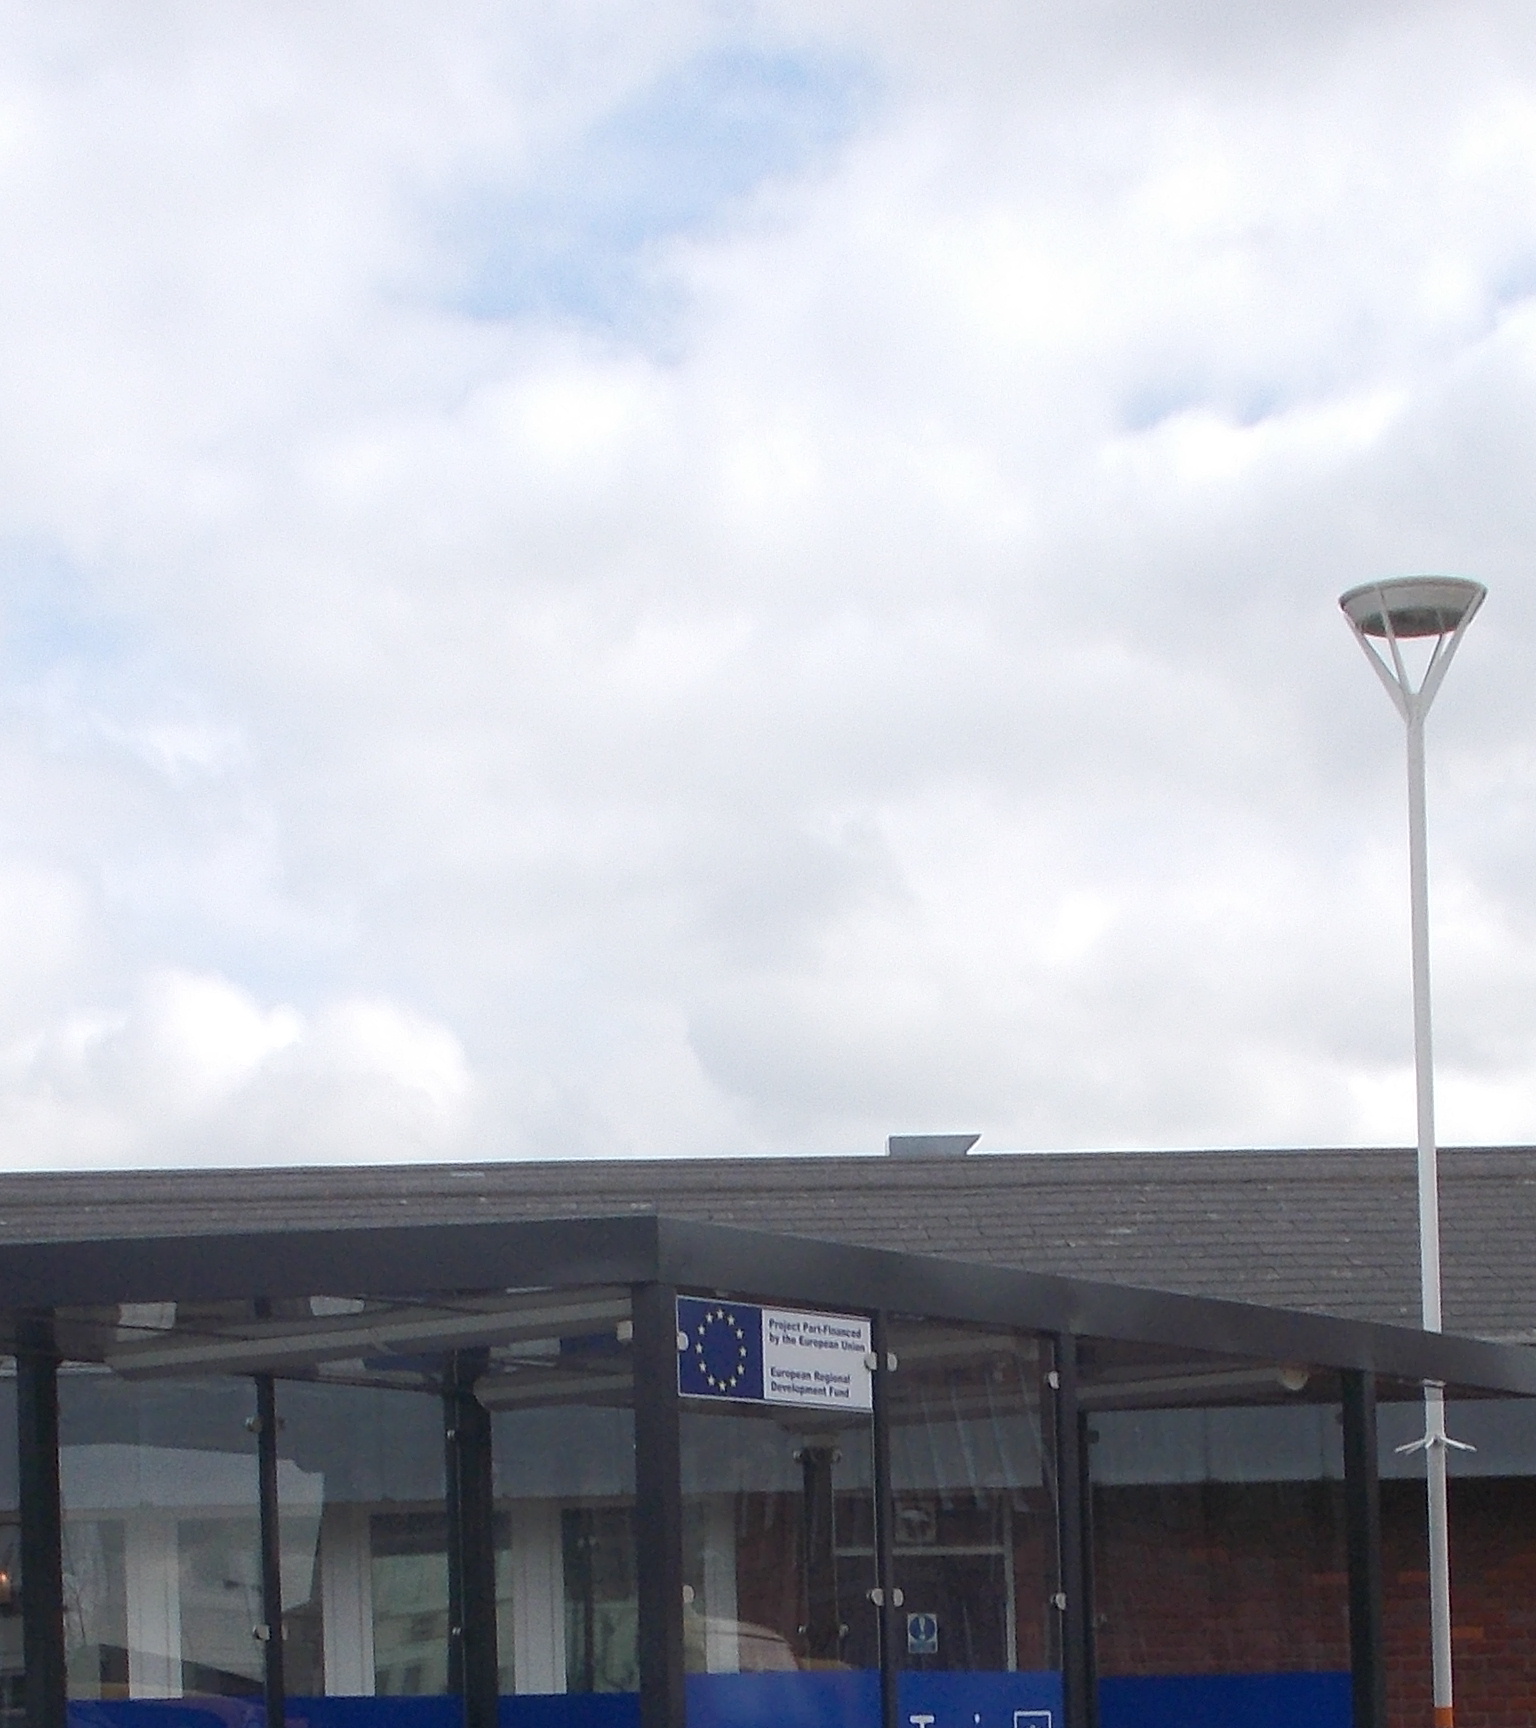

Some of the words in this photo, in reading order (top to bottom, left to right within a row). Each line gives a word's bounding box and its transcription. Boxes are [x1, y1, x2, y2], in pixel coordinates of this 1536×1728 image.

[769, 1318, 801, 1332] Project
[803, 1322, 862, 1339] Part-Financed
[769, 1332, 779, 1346] by
[782, 1334, 797, 1345] the
[799, 1335, 839, 1350] European
[841, 1340, 866, 1352] Union
[770, 1366, 811, 1381] European
[814, 1370, 850, 1384] Regional
[770, 1381, 827, 1396] Development
[829, 1385, 850, 1398] Fund
